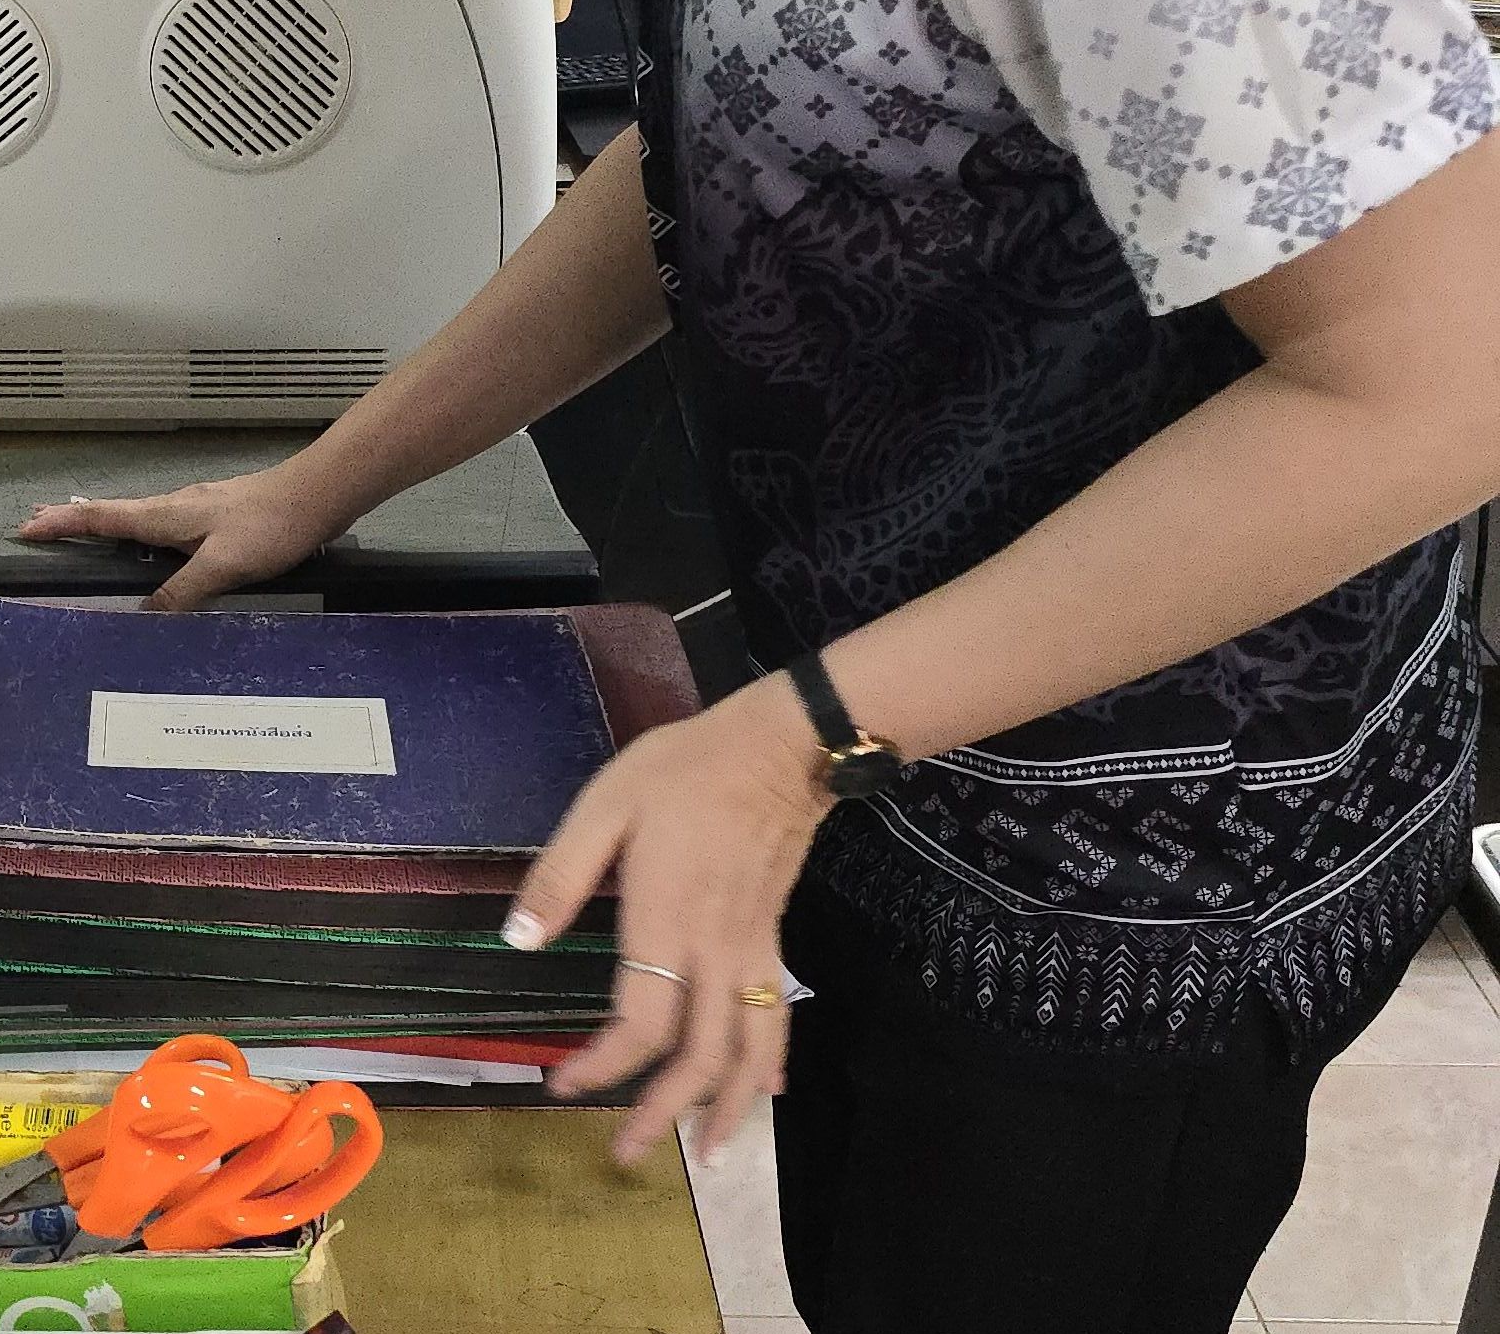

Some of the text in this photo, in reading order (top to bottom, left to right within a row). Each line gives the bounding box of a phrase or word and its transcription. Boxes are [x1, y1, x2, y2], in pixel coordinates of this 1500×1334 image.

[162, 724, 313, 739] ทะเบียนหนังสือส่ง
